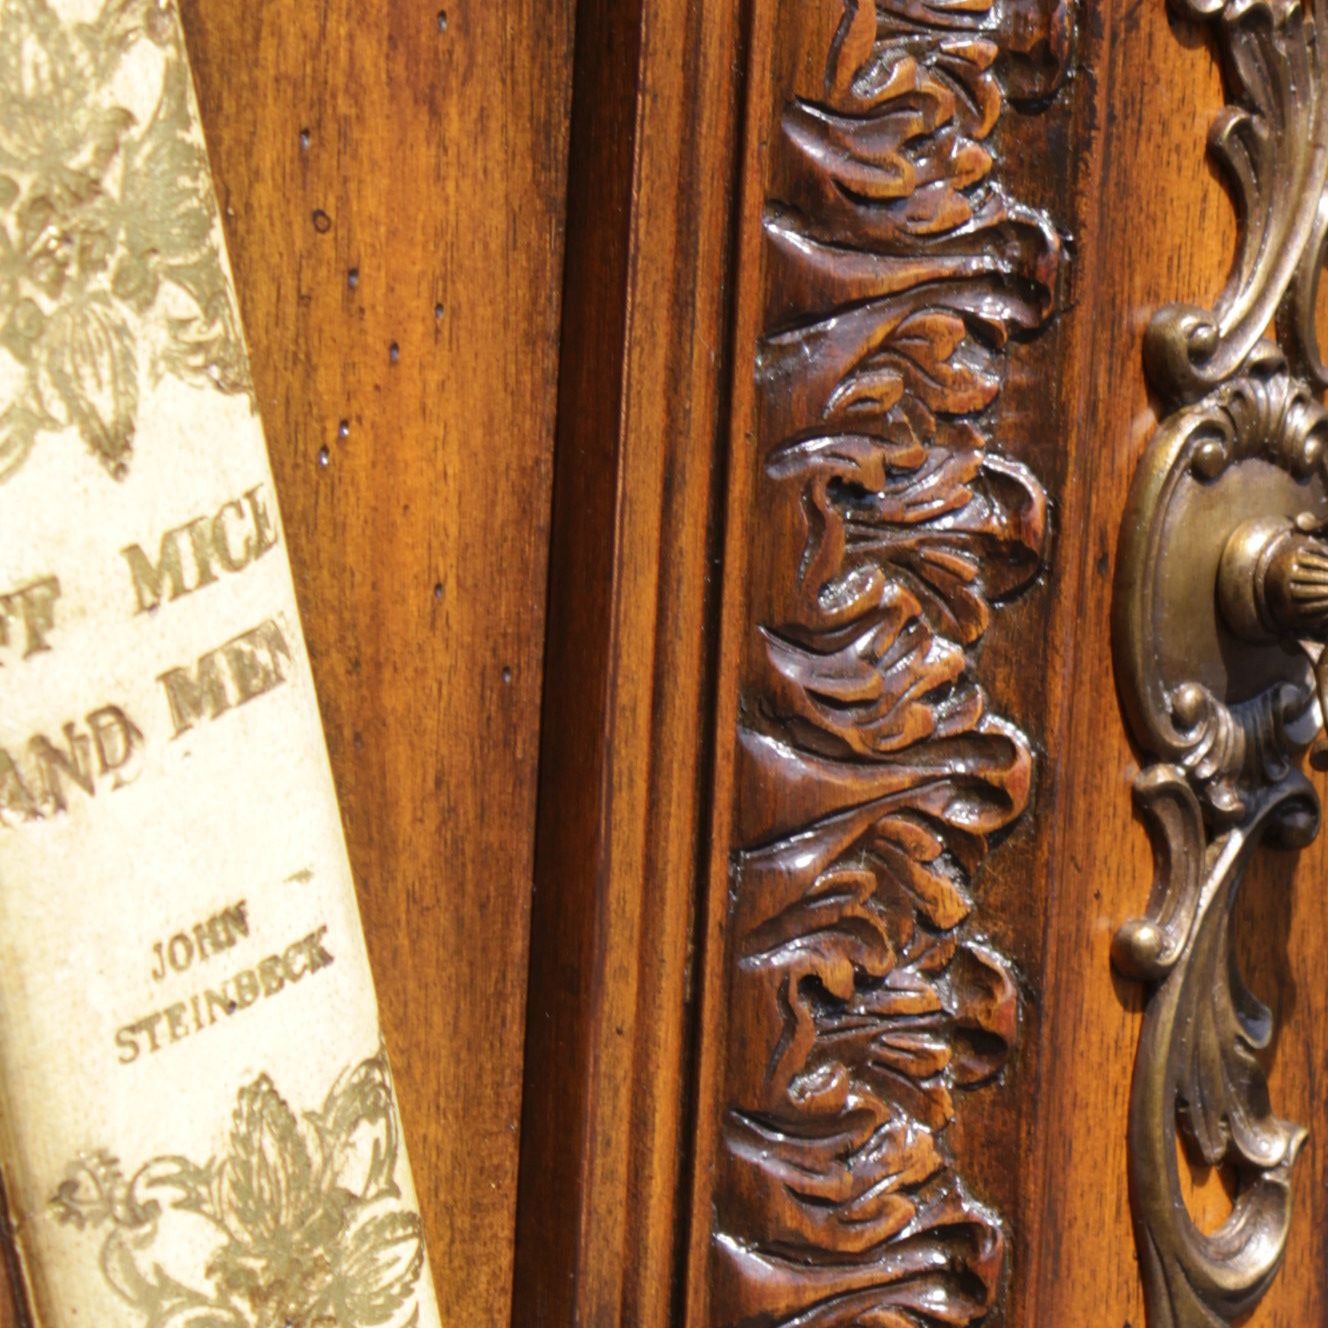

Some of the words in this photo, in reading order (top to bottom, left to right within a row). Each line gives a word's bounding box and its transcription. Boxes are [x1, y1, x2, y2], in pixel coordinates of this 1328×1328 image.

[120, 483, 278, 615] MICE
[156, 612, 294, 741] MEN
[115, 925, 334, 1065] STEINBECK
[152, 898, 249, 981] JOHN
